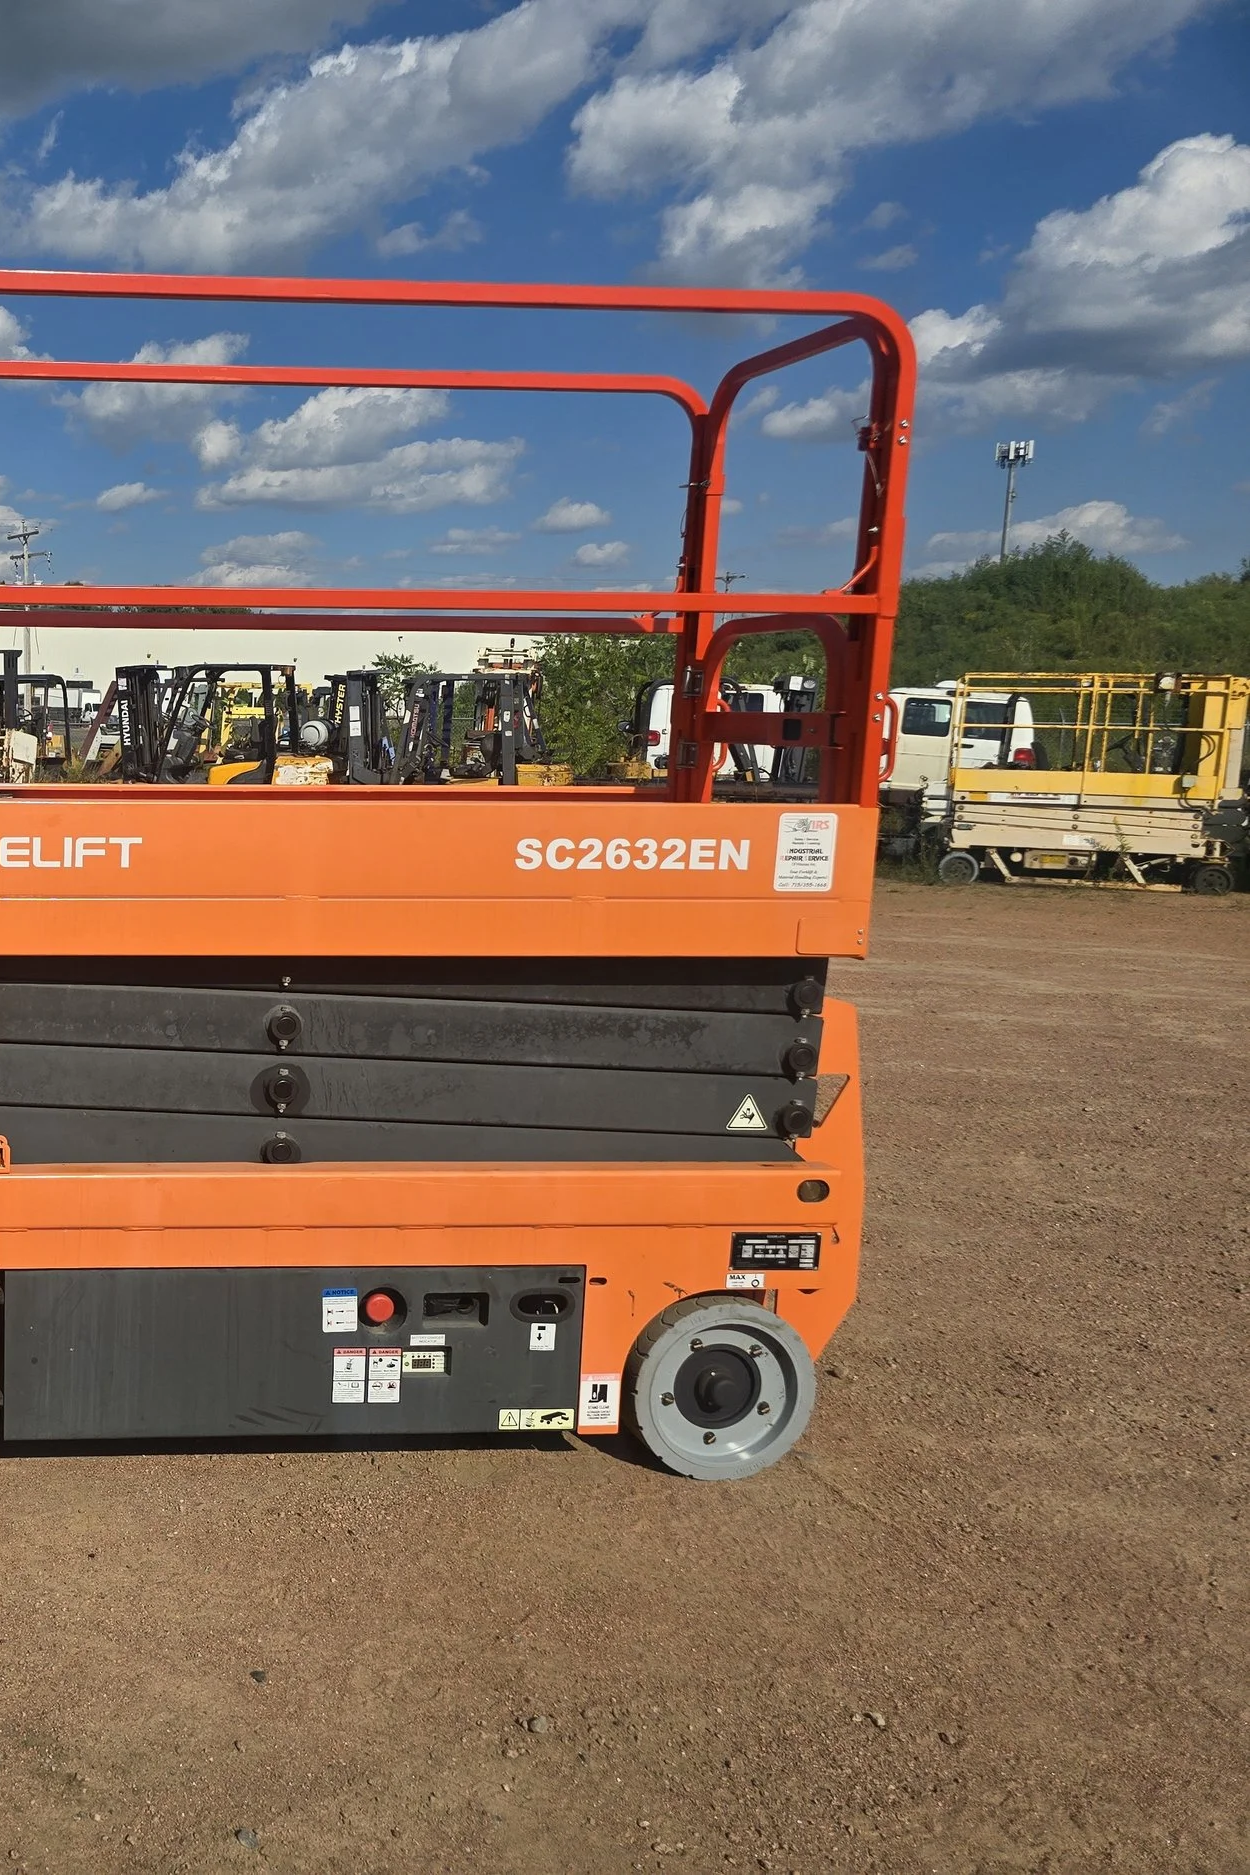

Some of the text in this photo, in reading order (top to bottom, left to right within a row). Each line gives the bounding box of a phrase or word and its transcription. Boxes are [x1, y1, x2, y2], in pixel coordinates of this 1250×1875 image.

[334, 683, 347, 724] HYSTER
[410, 703, 420, 738] KOMATSU
[120, 699, 131, 746] HYUNDAI
[812, 820, 830, 830] IRS
[514, 837, 751, 871] SC2632EN
